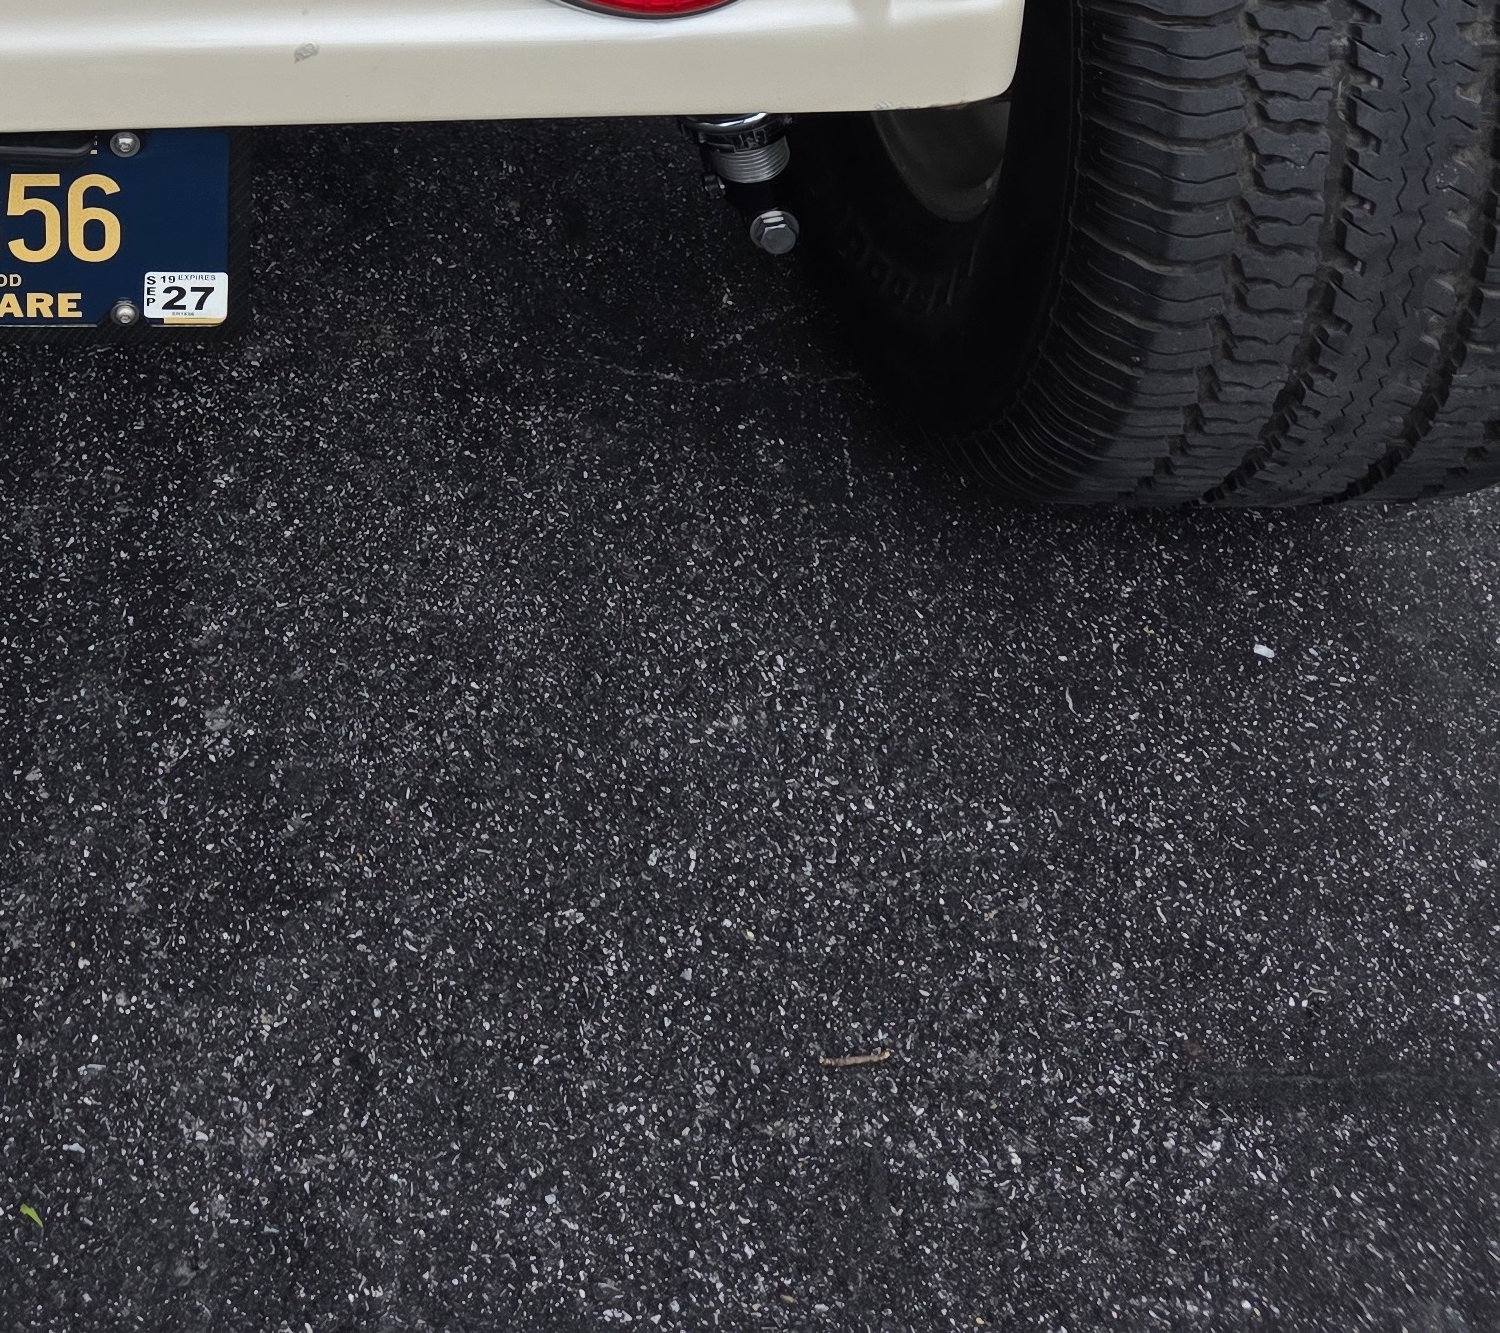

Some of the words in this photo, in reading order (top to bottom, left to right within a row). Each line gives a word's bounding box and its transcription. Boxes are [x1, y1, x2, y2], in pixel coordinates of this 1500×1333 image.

[146, 275, 156, 306] SEP
[160, 275, 176, 284] 19
[161, 286, 215, 311] 27
